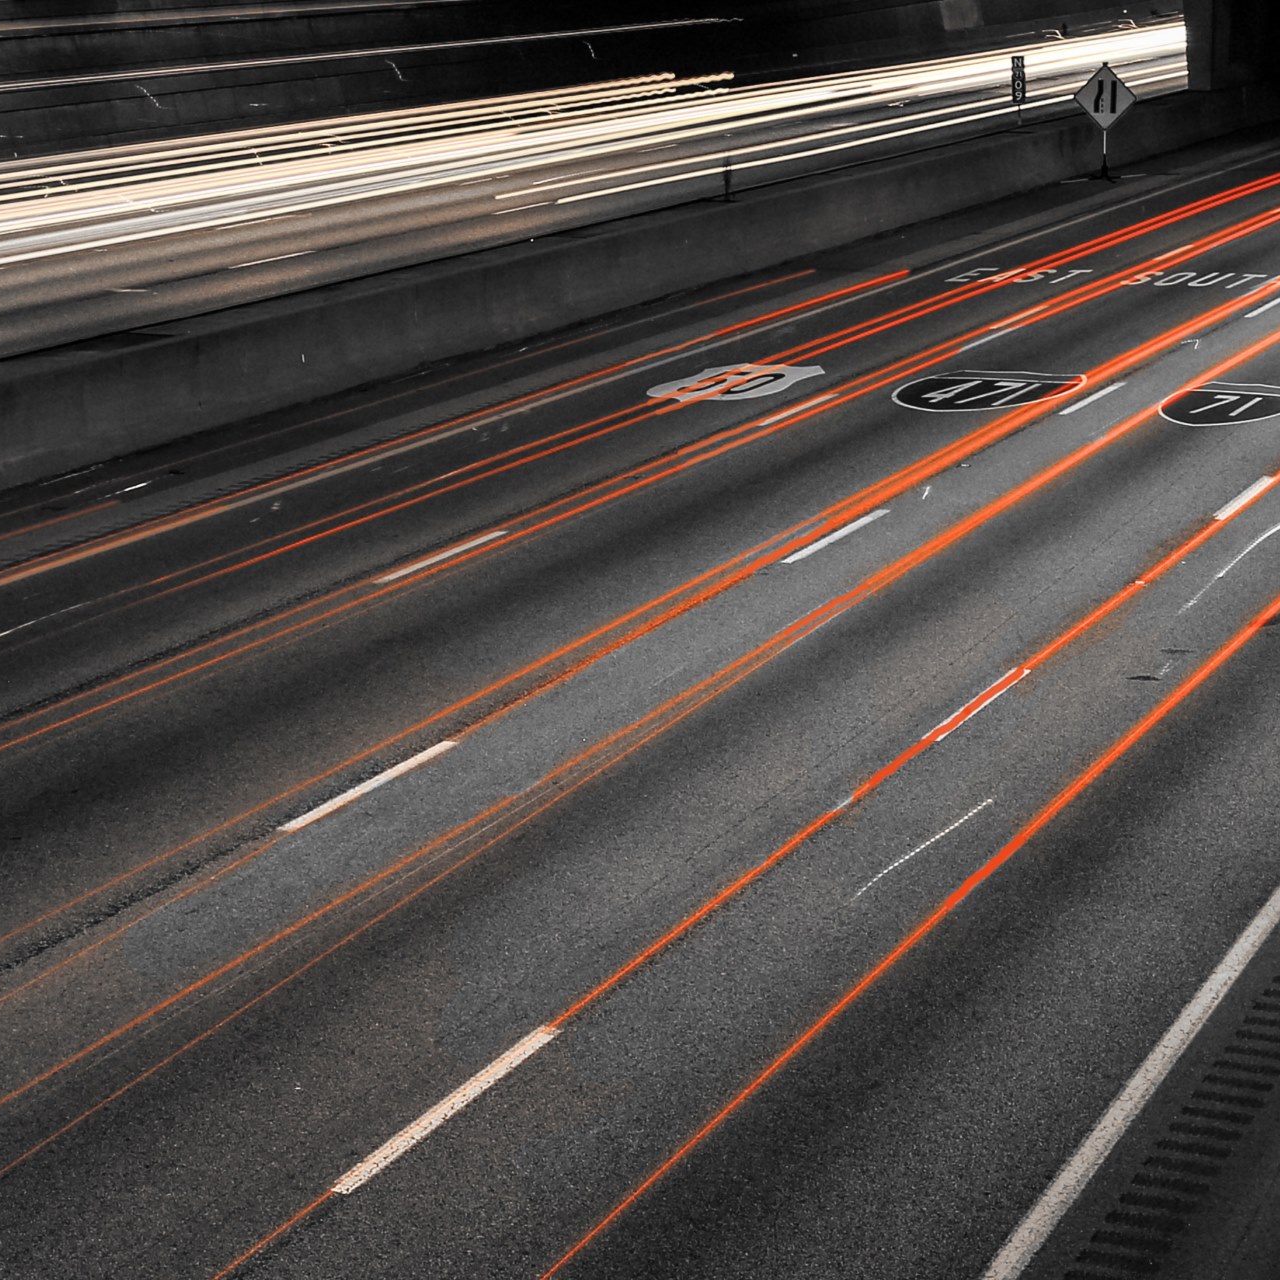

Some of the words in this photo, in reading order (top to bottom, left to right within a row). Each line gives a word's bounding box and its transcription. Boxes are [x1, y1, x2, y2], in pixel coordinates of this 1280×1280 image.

[944, 267, 1093, 284] EAST
[676, 371, 786, 395] 50
[920, 380, 1042, 407] 471
[1188, 394, 1264, 417] 71
